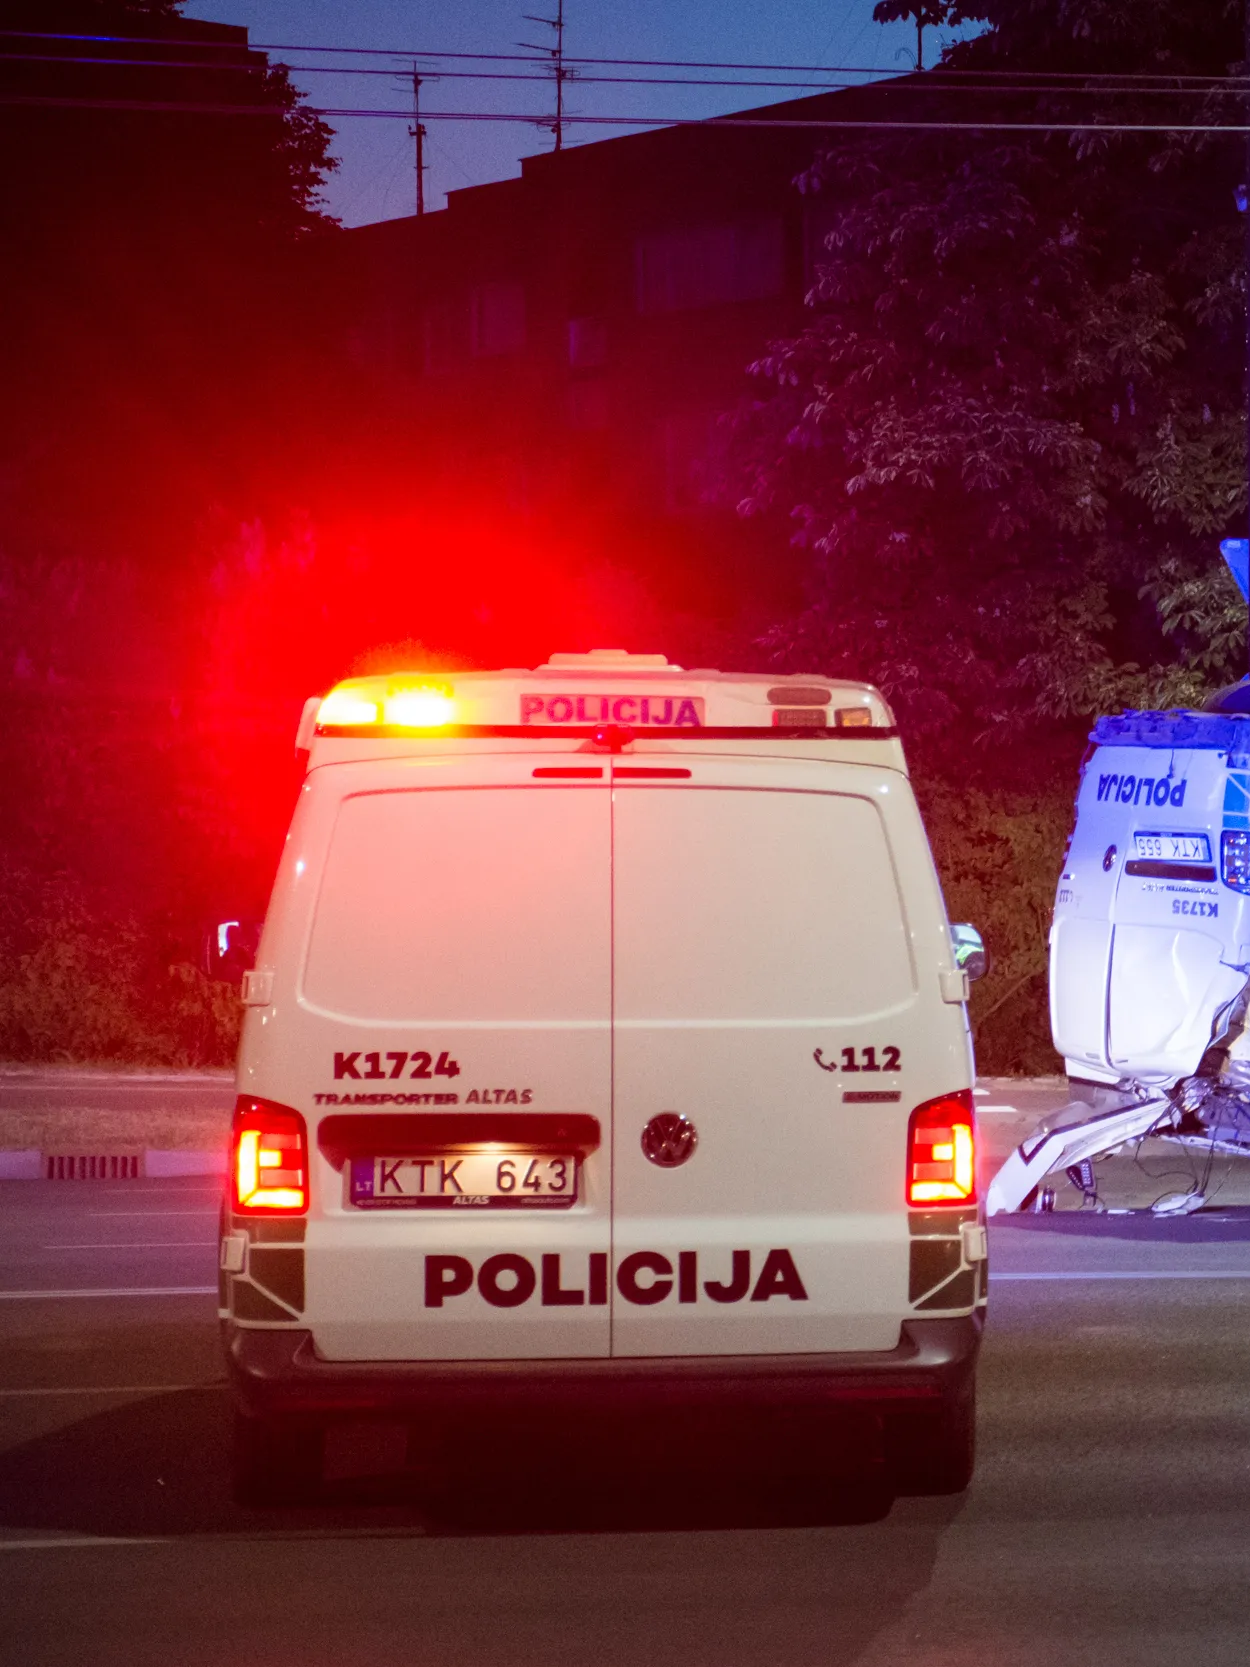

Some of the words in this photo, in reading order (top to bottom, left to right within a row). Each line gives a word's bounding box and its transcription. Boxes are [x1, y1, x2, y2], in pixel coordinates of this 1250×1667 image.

[521, 696, 702, 726] POLICIJA
[1096, 774, 1187, 807] POLICIJA
[1138, 838, 1162, 857] 655
[1170, 839, 1201, 857] KTK
[1171, 899, 1219, 918] K1735
[333, 1051, 461, 1080] K1724
[840, 1046, 902, 1072] 112
[313, 1092, 459, 1106] TRANSPORTER
[465, 1089, 533, 1105] ALTAS
[355, 1181, 372, 1193] LT
[380, 1159, 464, 1194] KTK
[496, 1158, 568, 1193] 643
[452, 1195, 490, 1206] ALTAS
[424, 1248, 809, 1308] POLICIJA
